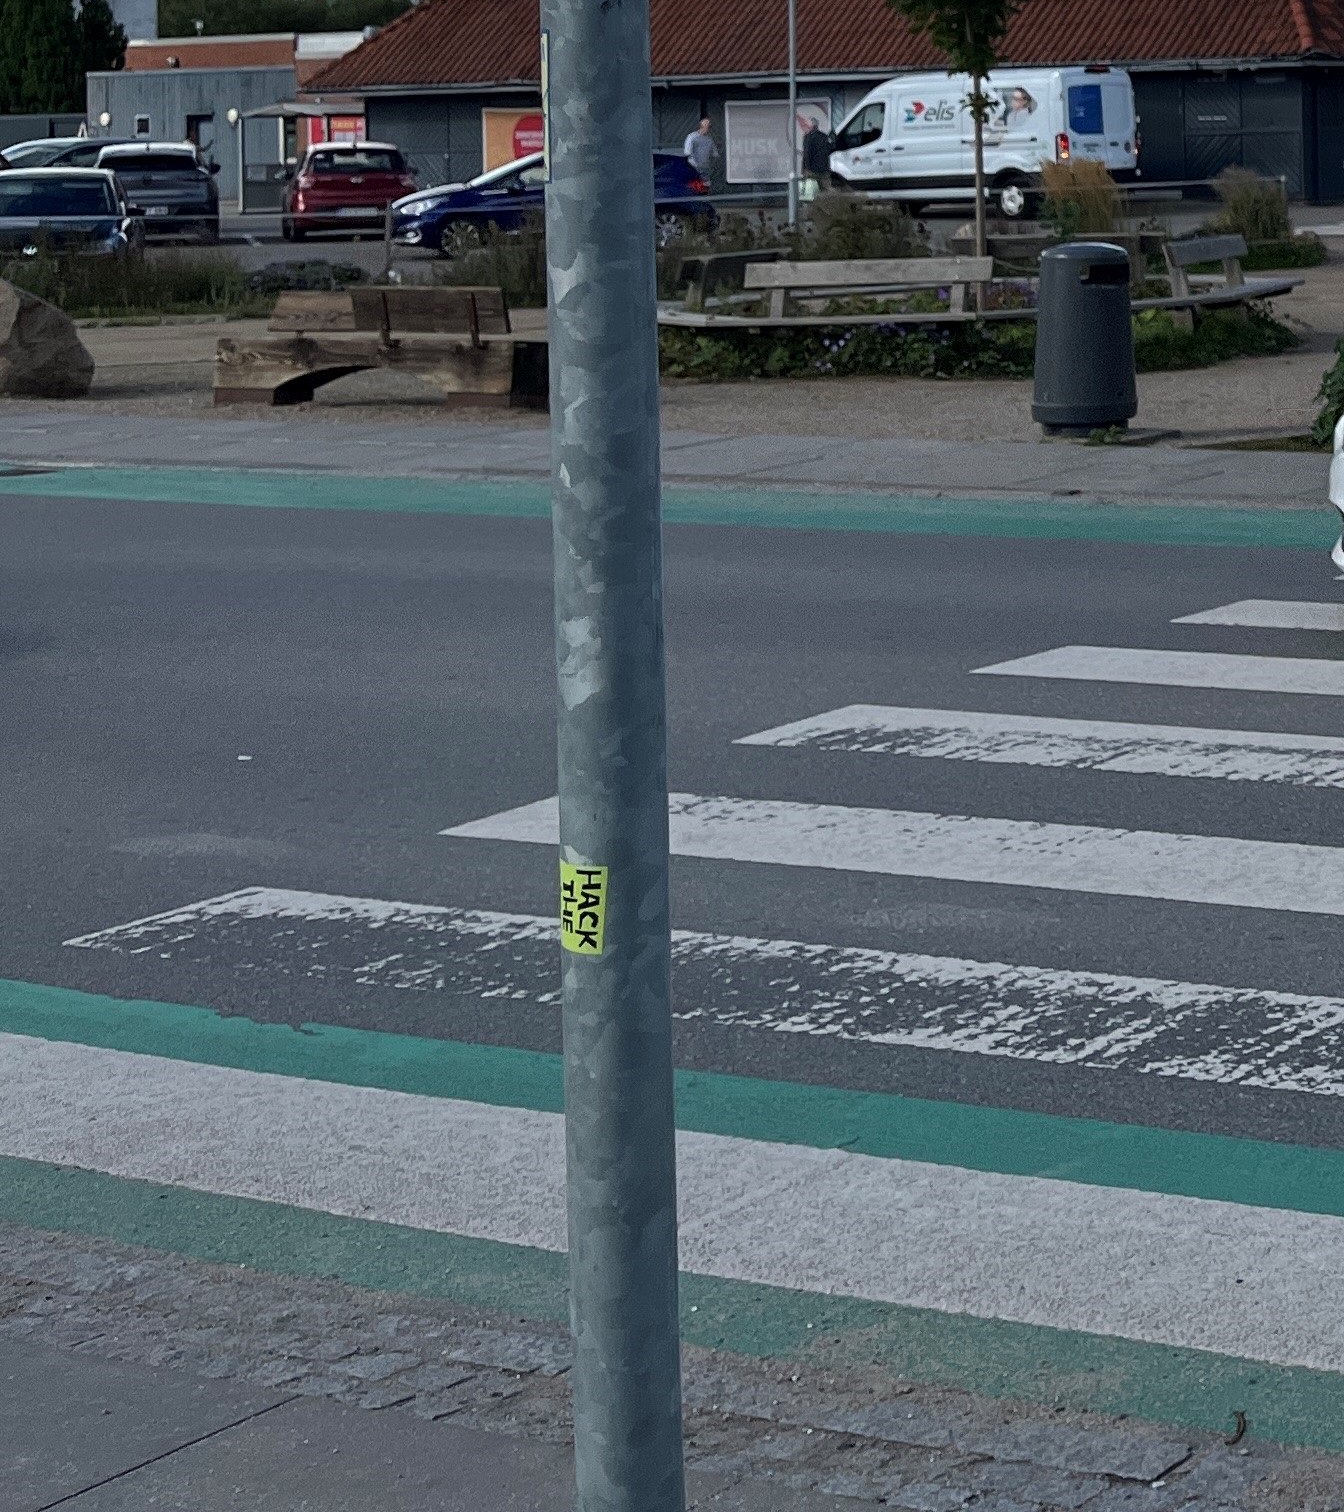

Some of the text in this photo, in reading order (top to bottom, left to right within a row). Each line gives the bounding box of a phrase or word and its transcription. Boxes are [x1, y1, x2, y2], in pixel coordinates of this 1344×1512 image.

[924, 99, 955, 122] elis
[562, 880, 578, 934] THE
[575, 869, 602, 949] HACK
